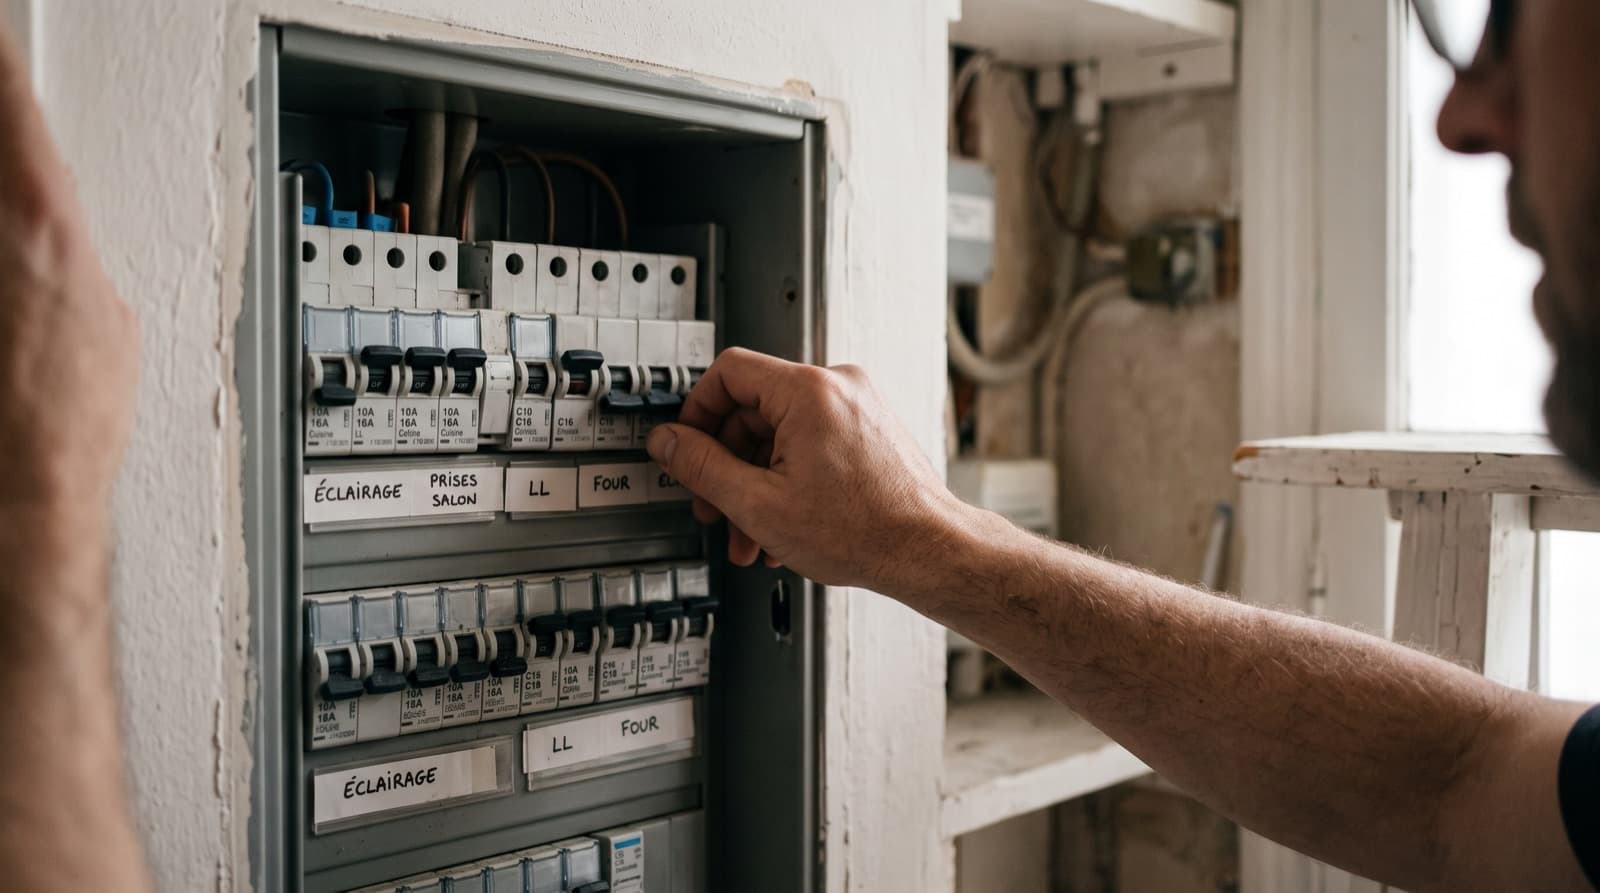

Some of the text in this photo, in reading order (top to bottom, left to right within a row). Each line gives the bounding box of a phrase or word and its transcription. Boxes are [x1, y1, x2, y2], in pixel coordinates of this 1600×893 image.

[312, 407, 330, 417] 10A
[357, 407, 374, 417] 10A
[400, 407, 418, 417] 10A
[443, 407, 460, 417] 10A
[516, 407, 533, 416] C10
[311, 418, 329, 428] 16A
[400, 418, 417, 428] 16A
[442, 417, 459, 427] 16A
[558, 417, 574, 426] C16
[529, 480, 550, 496] LL
[593, 475, 630, 491] FOUR
[432, 493, 477, 507] SALON
[563, 666, 578, 675] 10A
[406, 689, 423, 699] 10A
[621, 715, 659, 736] FOUR
[552, 736, 573, 753] LL
